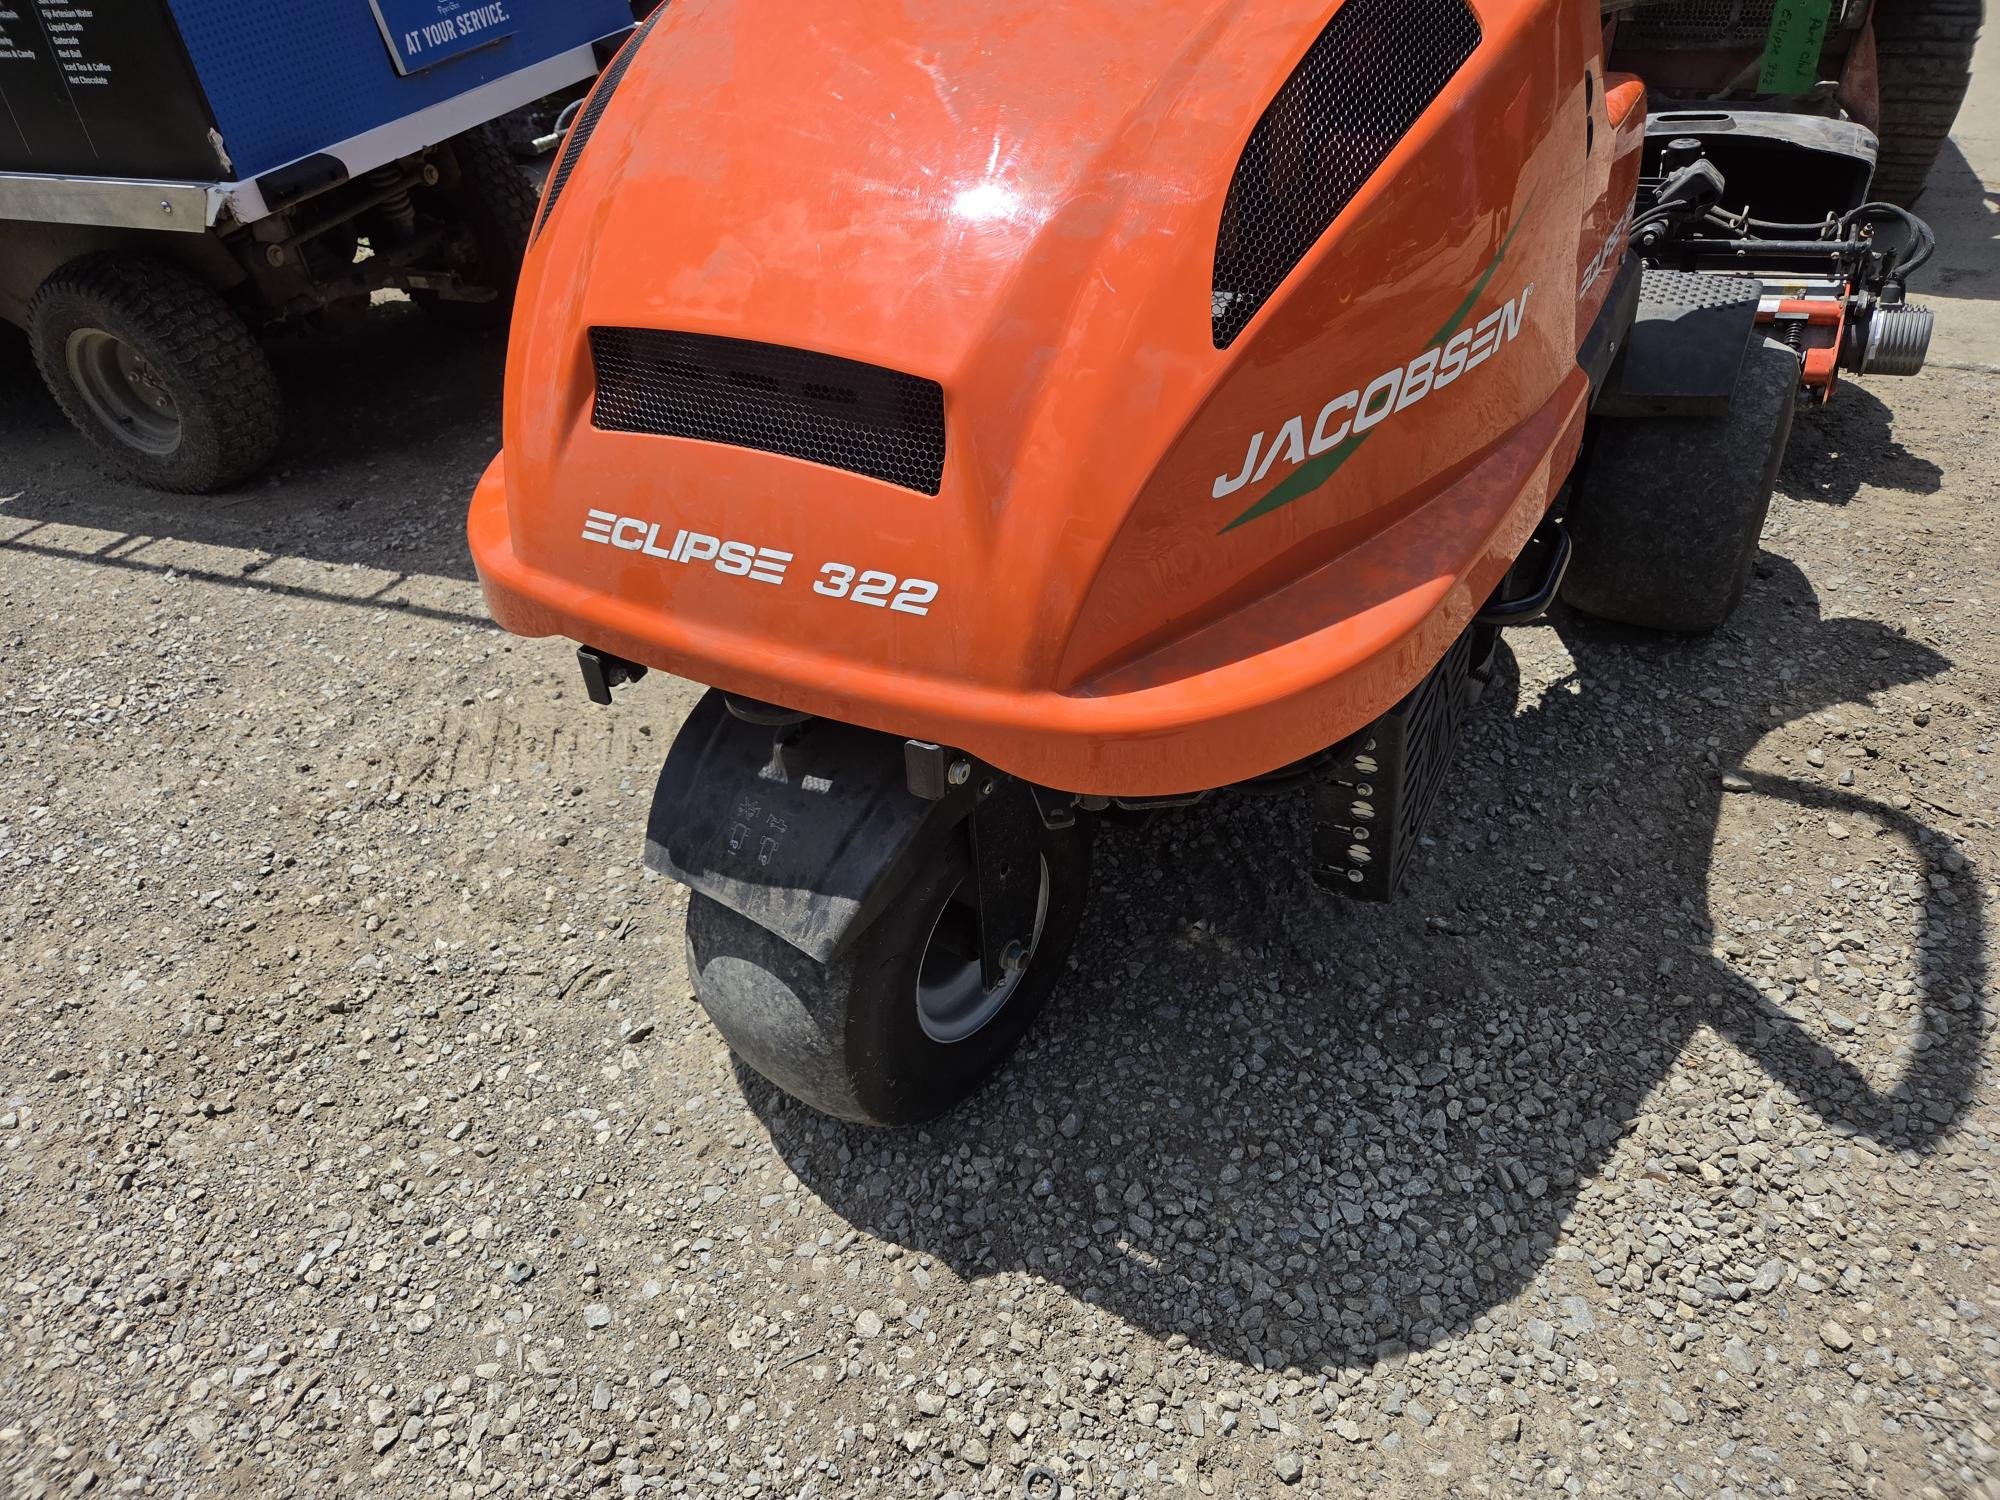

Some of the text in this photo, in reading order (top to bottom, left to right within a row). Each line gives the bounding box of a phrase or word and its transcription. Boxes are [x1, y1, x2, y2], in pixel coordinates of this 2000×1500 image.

[51, 9, 76, 18] Artesian
[74, 9, 93, 18] Water
[47, 22, 84, 33] Liquid Death
[404, 2, 510, 56] AT YOUR SERVICE.
[52, 36, 80, 45] Gatorade
[57, 49, 83, 58] Red Bull
[63, 62, 77, 71] Iced
[75, 62, 87, 71] Tea
[92, 62, 112, 72] Coffee
[68, 75, 109, 85] Hot Chocolate
[1211, 287, 1530, 499] JACOBSEN
[581, 508, 939, 616] ECLIPSE 322
